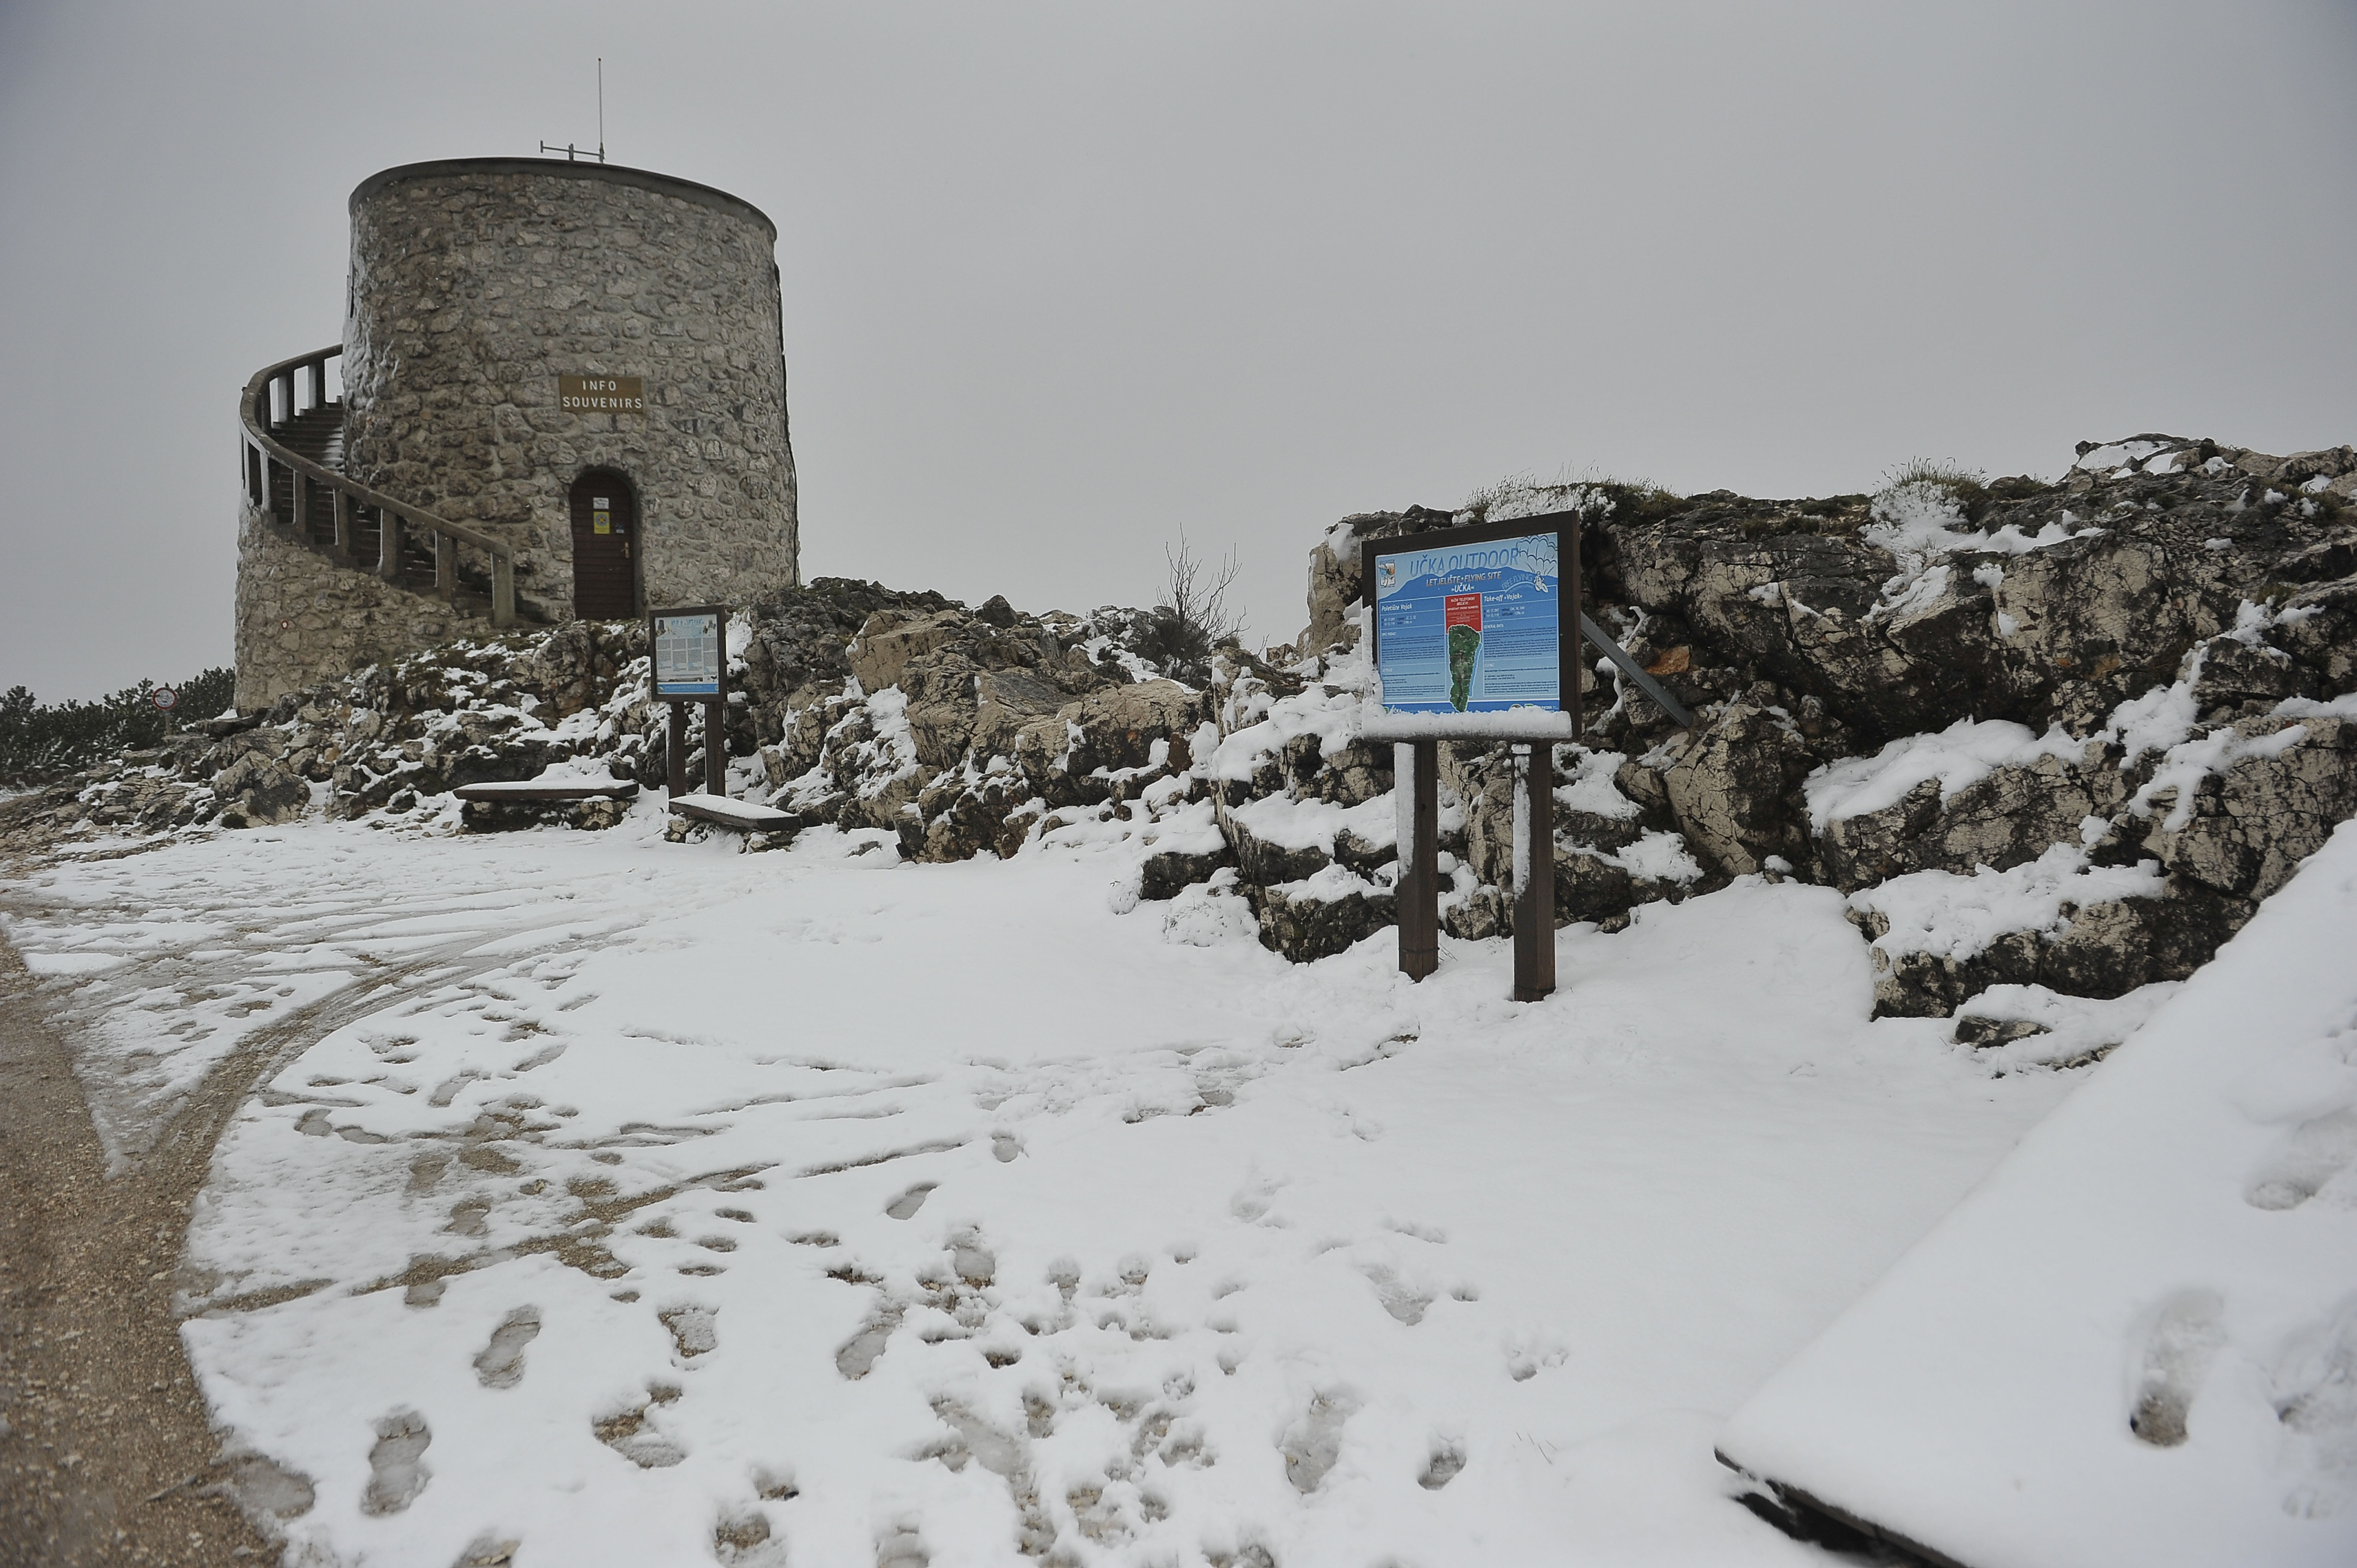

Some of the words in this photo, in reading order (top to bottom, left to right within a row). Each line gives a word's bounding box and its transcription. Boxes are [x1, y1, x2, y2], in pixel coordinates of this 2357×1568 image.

[582, 380, 616, 391] INFO
[563, 396, 642, 409] SOUVENIRS
[1410, 555, 1446, 577] UČKA
[1449, 547, 1519, 570] OUTDOOR
[1426, 574, 1460, 587] LETJELIŠTE
[1464, 573, 1485, 582] FLYING
[1487, 571, 1502, 580] SITE
[1501, 578, 1513, 589] FREE
[1513, 573, 1532, 583] FLYING
